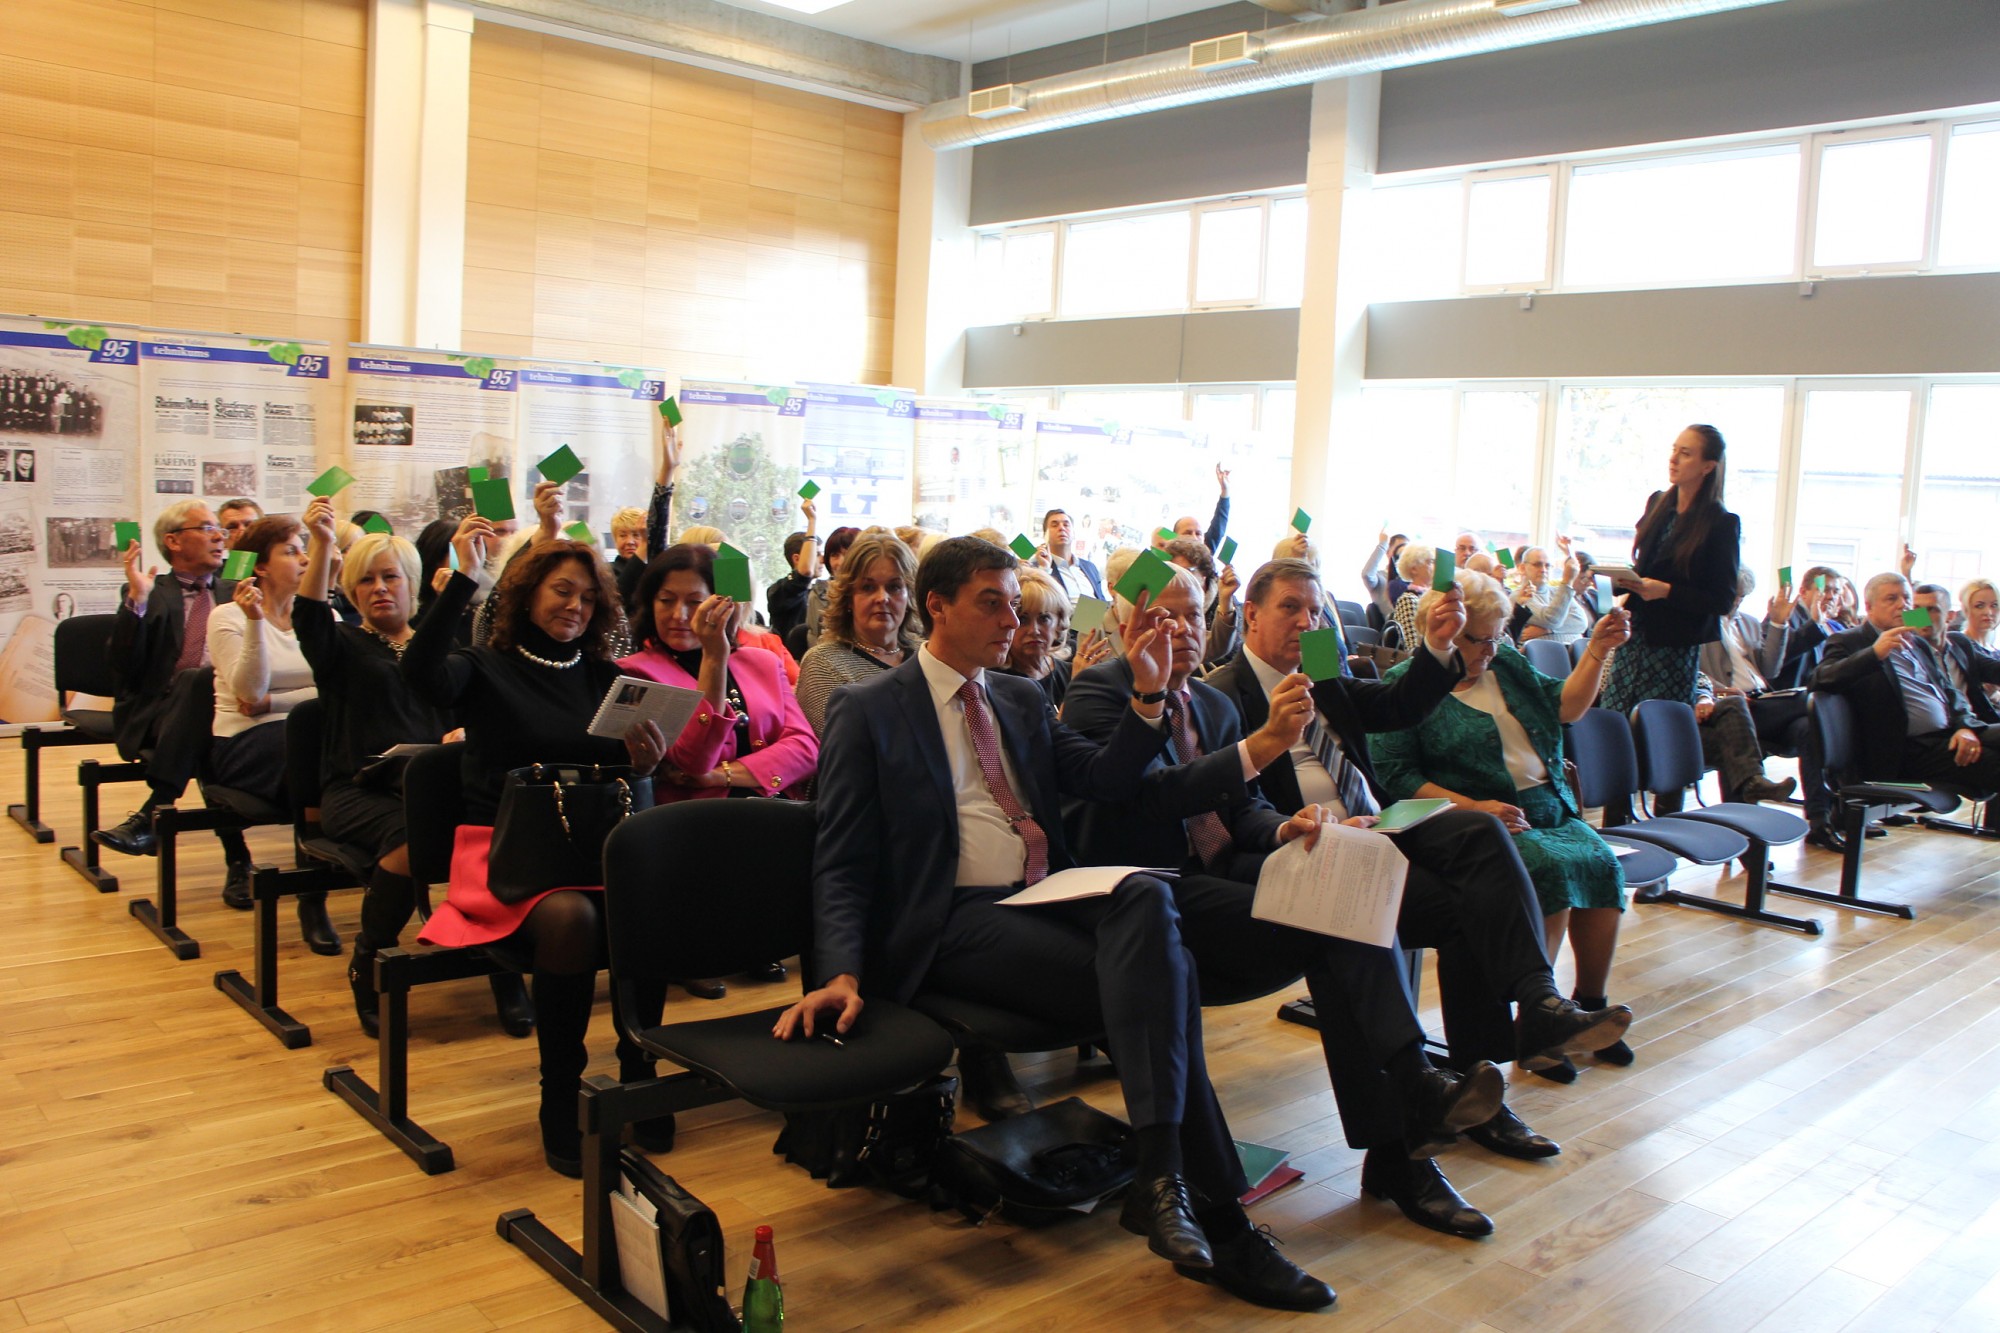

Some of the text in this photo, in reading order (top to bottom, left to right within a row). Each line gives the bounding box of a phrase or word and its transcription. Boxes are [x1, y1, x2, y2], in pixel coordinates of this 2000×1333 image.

[102, 340, 131, 357] 95
[153, 345, 210, 358] tehnikums
[298, 356, 323, 371] 95
[360, 360, 411, 372] tehnikums
[489, 370, 513, 386] 95
[641, 380, 661, 395] 95
[785, 398, 802, 412] 95
[894, 400, 911, 413] 95
